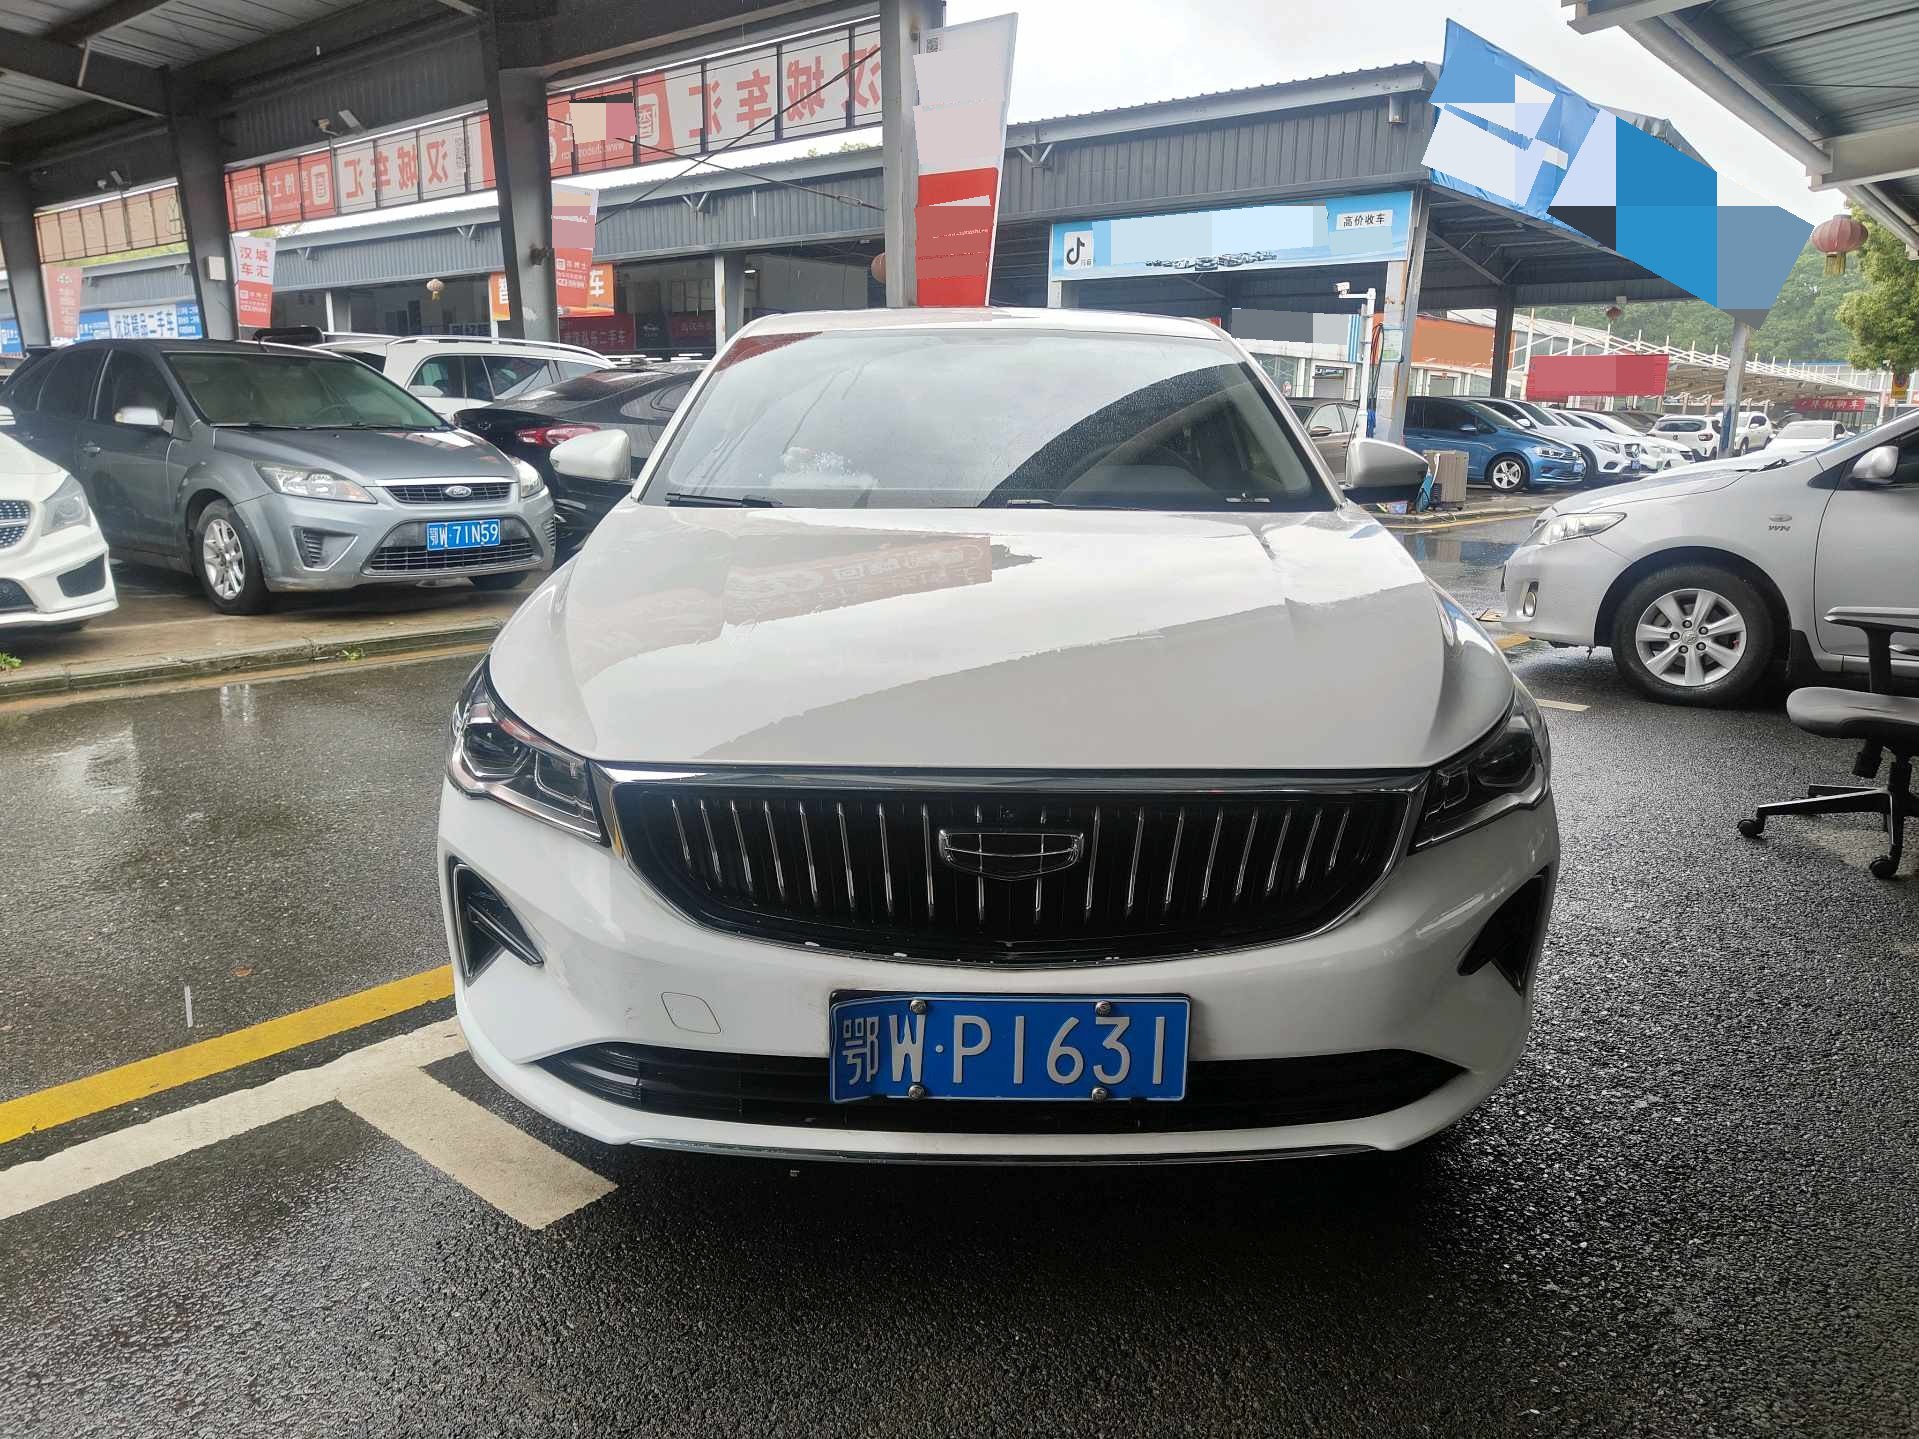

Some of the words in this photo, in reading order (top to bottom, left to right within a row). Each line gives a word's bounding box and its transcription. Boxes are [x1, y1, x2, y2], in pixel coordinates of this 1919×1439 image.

[1343, 212, 1385, 227] 高价收车
[240, 247, 269, 263] 汉城
[241, 263, 269, 278] 车汇
[842, 1014, 1167, 1086] 鄂W·P1631
